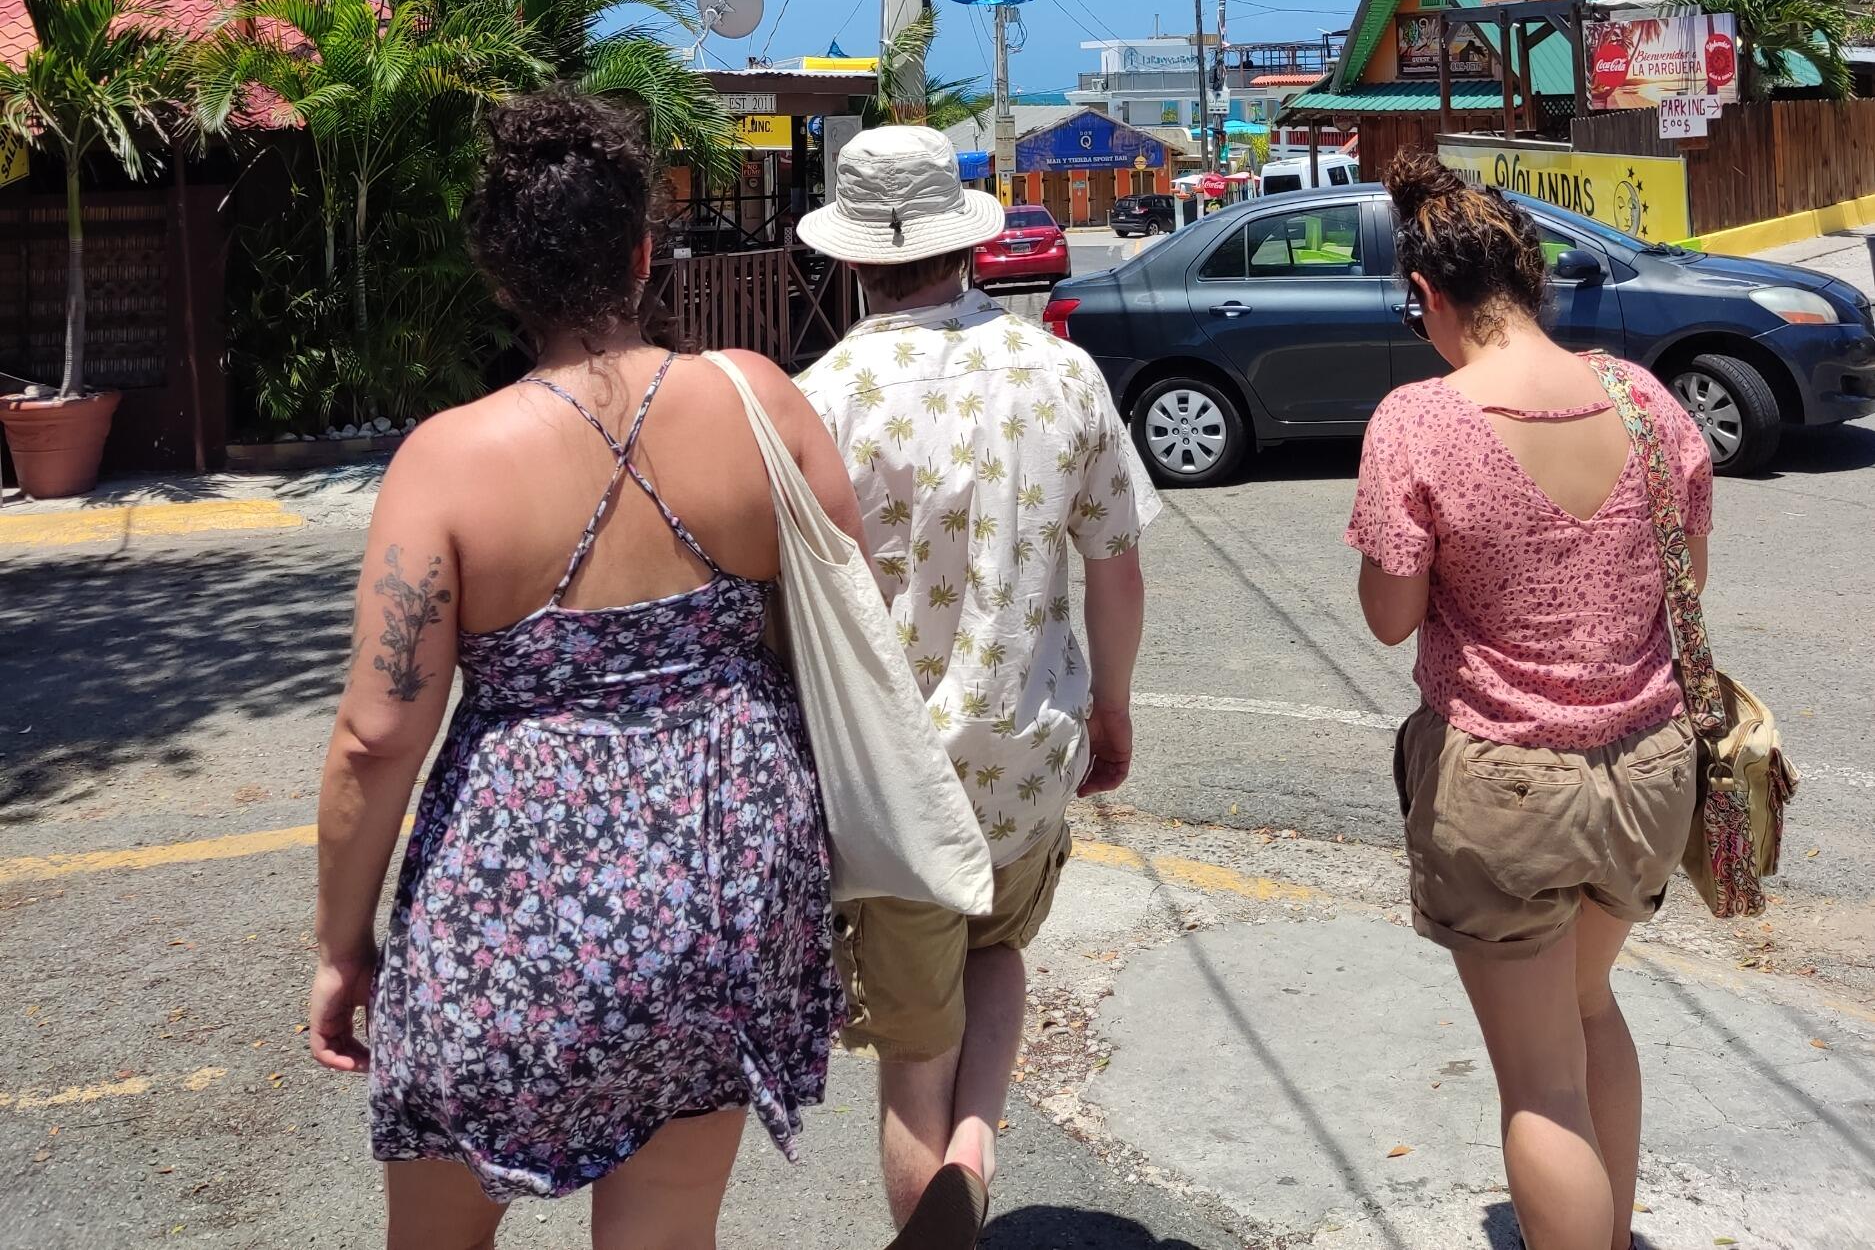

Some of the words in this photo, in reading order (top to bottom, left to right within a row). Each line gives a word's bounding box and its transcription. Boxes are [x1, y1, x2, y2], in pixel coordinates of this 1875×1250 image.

[1635, 50, 1688, 63] Bienvenidos
[1632, 64, 1645, 76] LA
[1650, 61, 1702, 75] PARGUERA
[729, 98, 746, 110] EST
[753, 98, 773, 110] 2011
[1661, 98, 1706, 117] PARKING
[1080, 135, 1092, 149] Q
